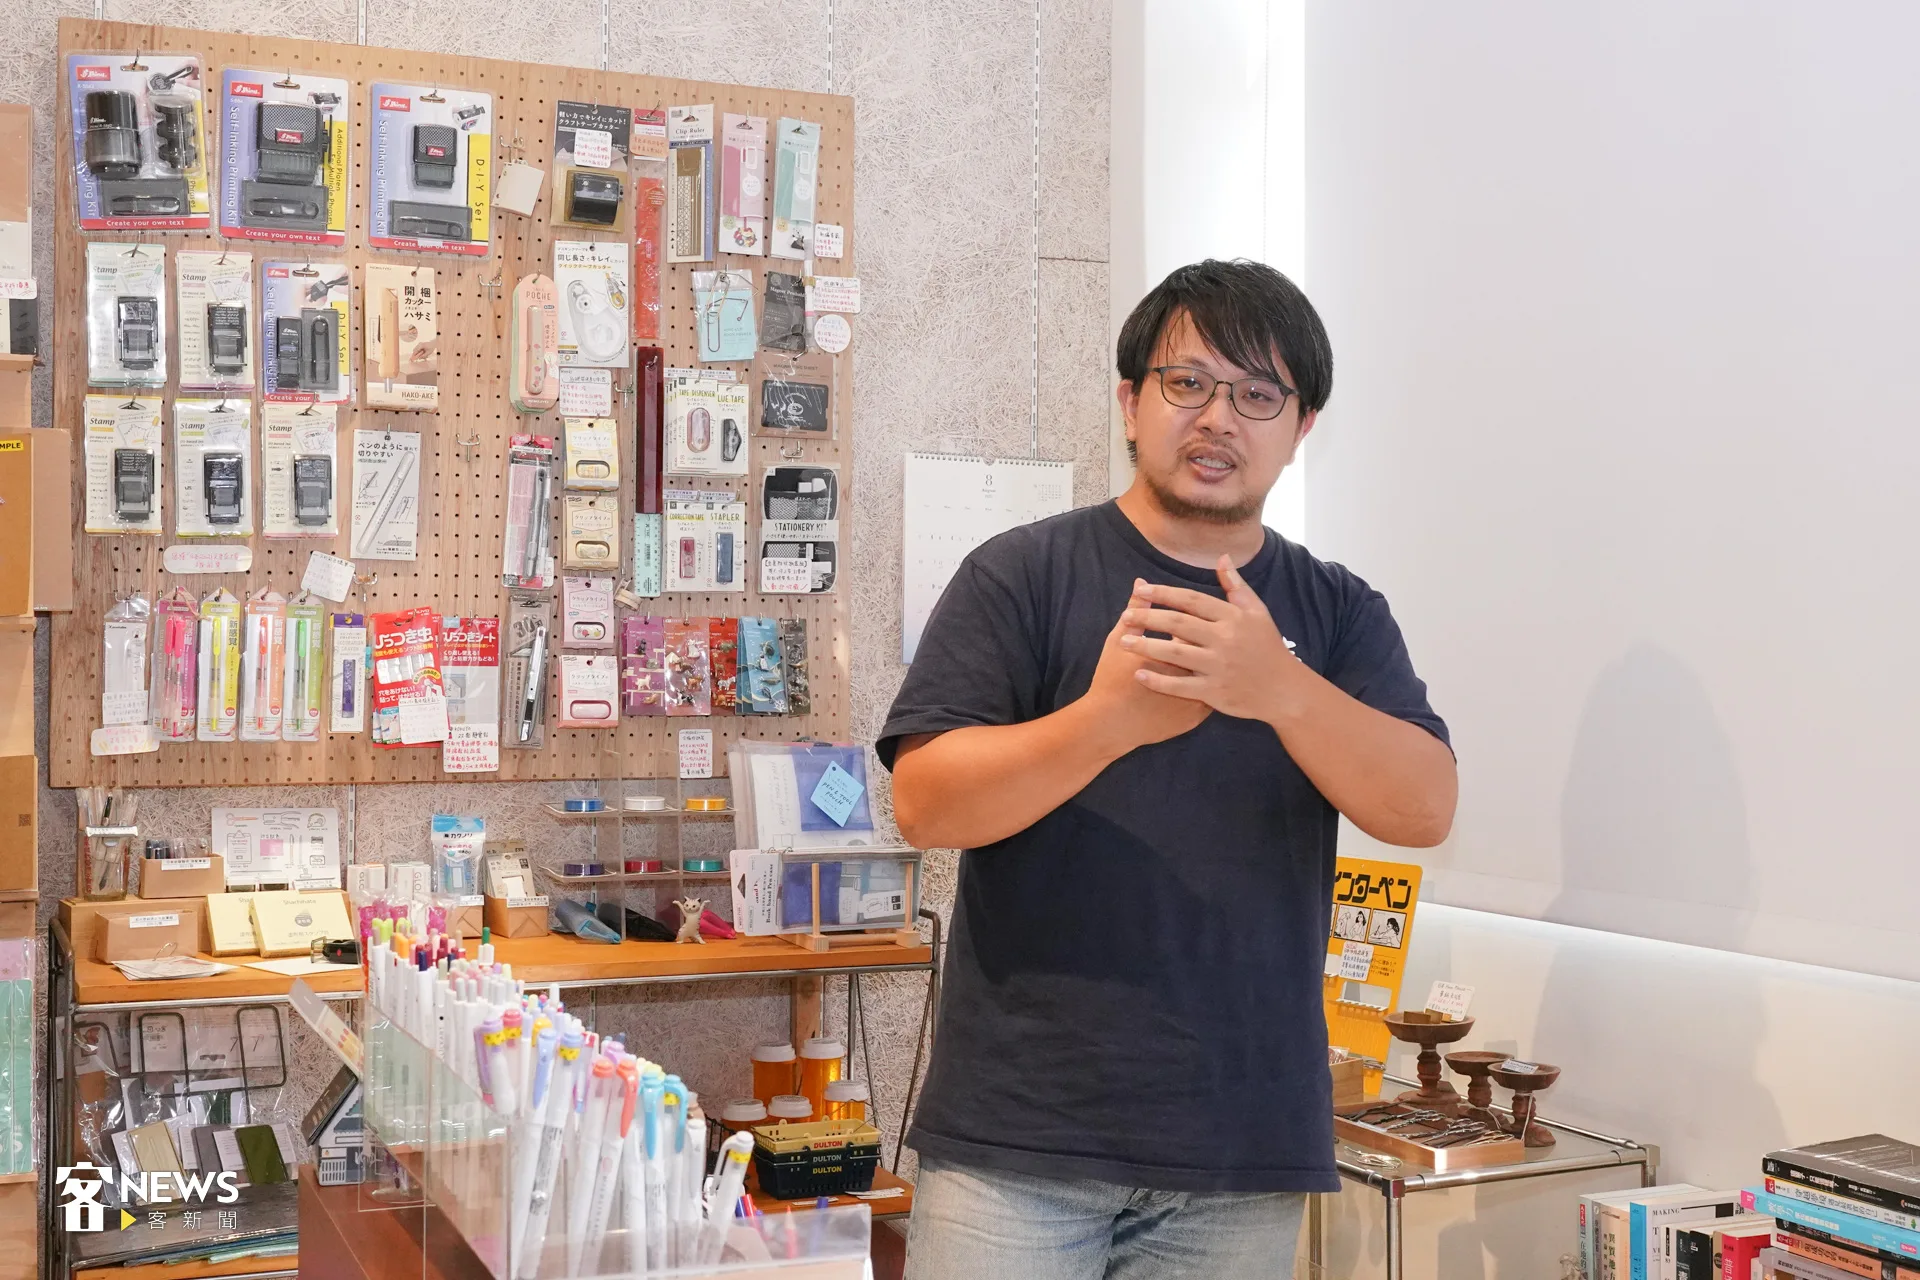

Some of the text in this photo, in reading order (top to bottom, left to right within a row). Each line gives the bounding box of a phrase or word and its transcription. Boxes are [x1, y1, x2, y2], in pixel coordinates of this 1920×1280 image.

[226, 166, 239, 207] Printing
[227, 210, 238, 225] Kit
[245, 230, 269, 238] Create
[182, 273, 207, 282] Stamp
[404, 297, 432, 306] カッター
[404, 312, 432, 322] ハサミ
[731, 394, 745, 403] TAPE
[89, 418, 115, 426] Stamp
[180, 422, 206, 431] Stamp
[268, 425, 293, 433] Stamp
[358, 450, 394, 458] 切りやすい
[985, 474, 993, 486] 8
[710, 512, 740, 521] STAPLER
[775, 522, 815, 532] STATIONERY
[443, 632, 496, 643] ひっつきシート
[813, 1140, 843, 1150] DULTON
[813, 1154, 842, 1163] DULTON
[812, 1165, 842, 1175] DULTON
[1652, 1208, 1680, 1217] MAKING
